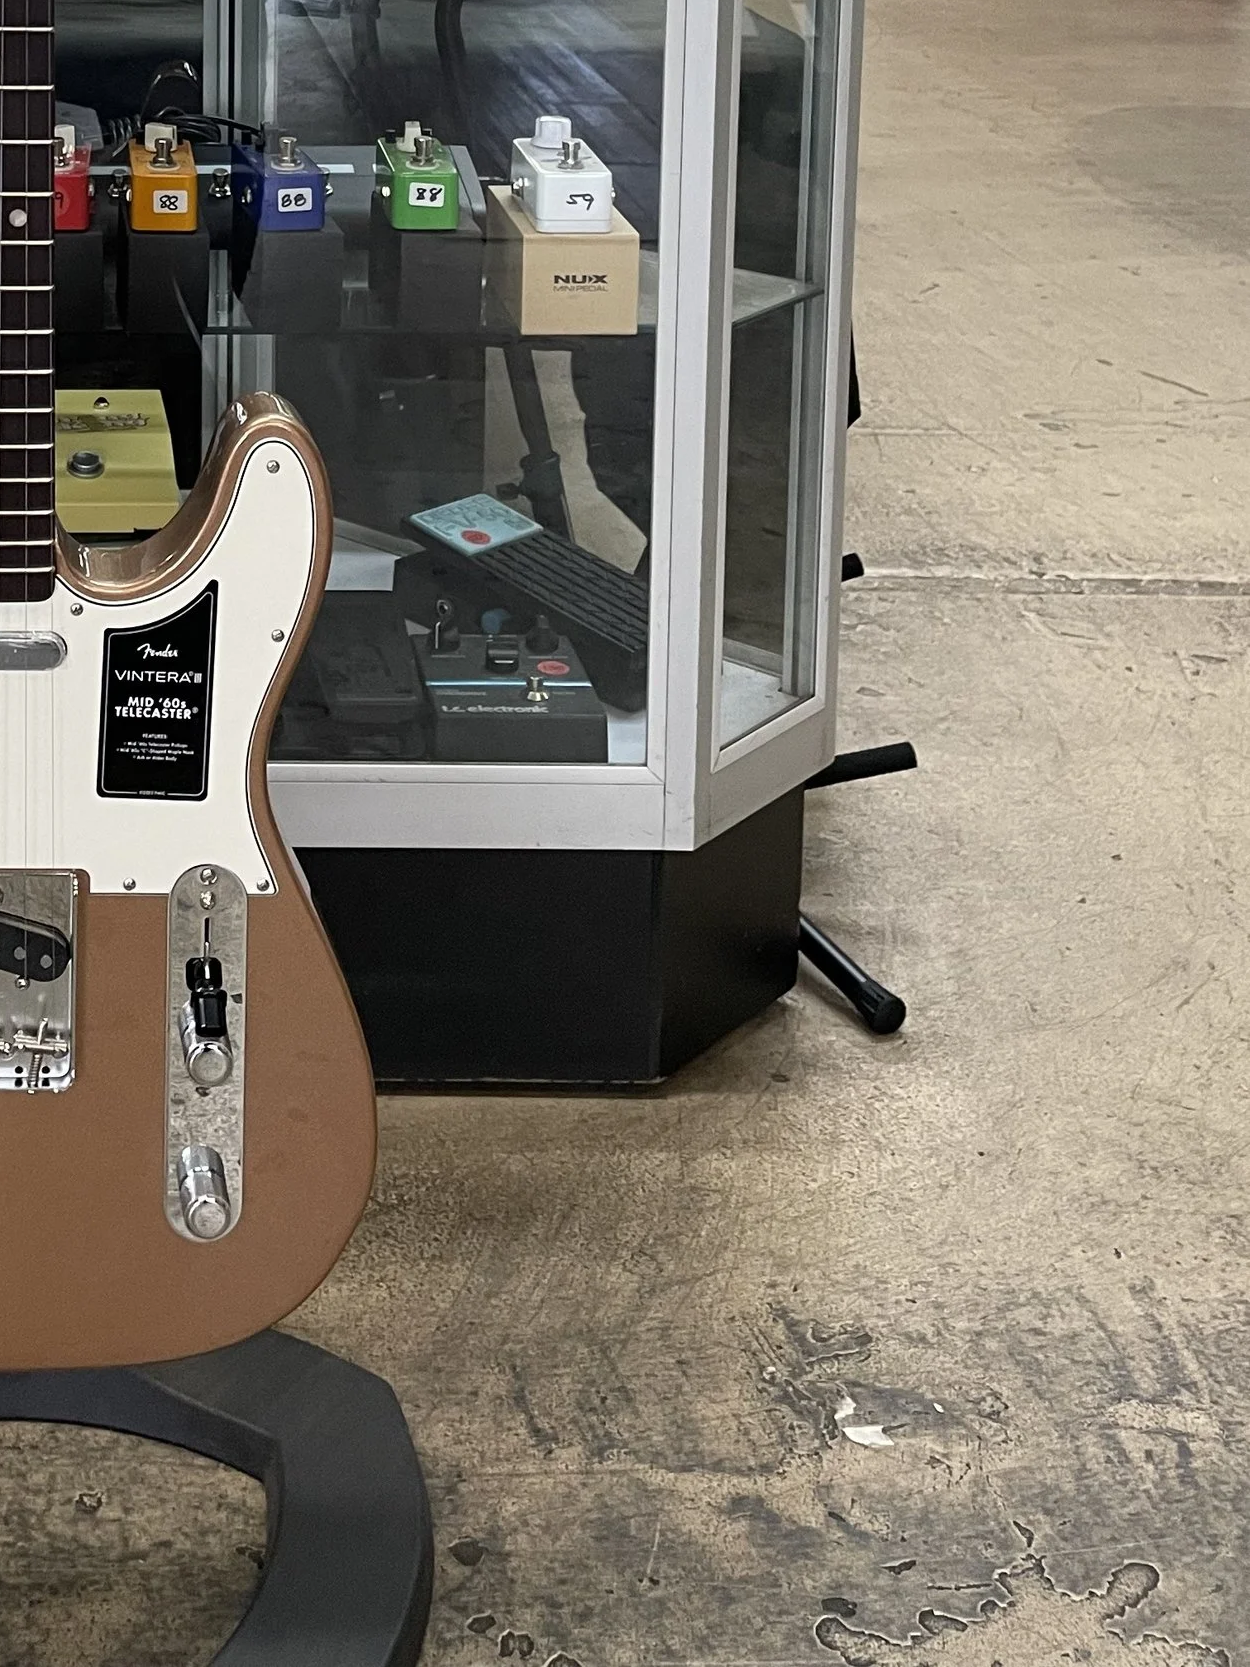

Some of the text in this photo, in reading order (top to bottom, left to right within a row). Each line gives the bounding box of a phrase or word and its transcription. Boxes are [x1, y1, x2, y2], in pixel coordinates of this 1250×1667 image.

[159, 194, 179, 211] 88
[280, 193, 307, 209] 88
[415, 187, 443, 203] 88
[566, 193, 595, 211] 59
[553, 274, 608, 284] NUX
[136, 642, 179, 660] Fender
[127, 696, 155, 708] MID
